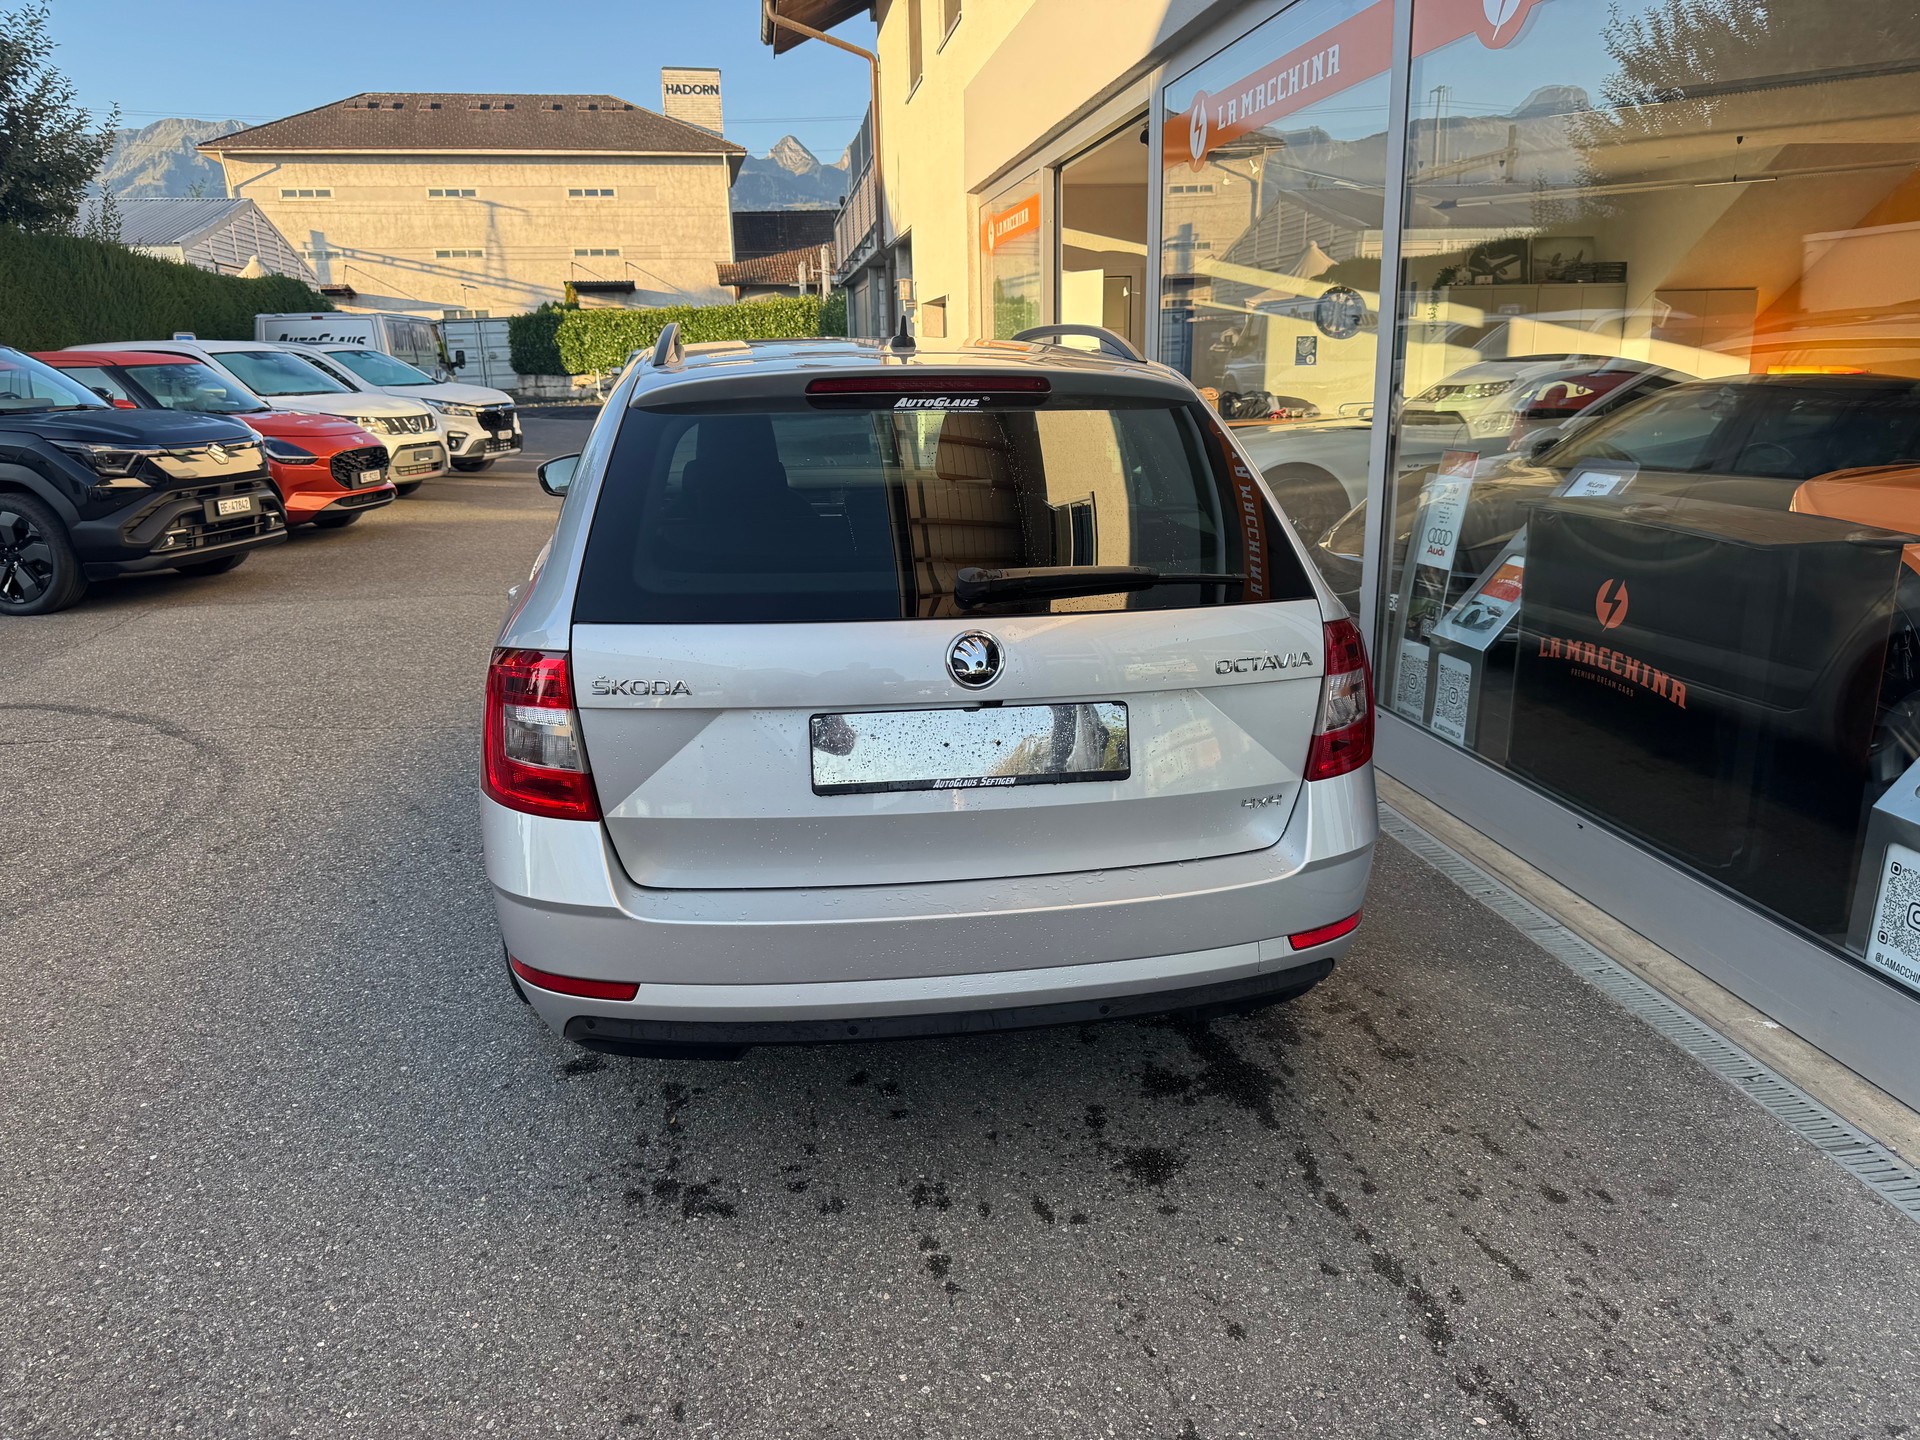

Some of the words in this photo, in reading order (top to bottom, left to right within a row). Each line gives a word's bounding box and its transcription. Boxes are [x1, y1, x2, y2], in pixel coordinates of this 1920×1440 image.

[665, 83, 719, 95] HADORN
[1217, 98, 1237, 131] LA
[1240, 43, 1340, 119] MACCHINA
[1427, 545, 1446, 557] Audi
[1215, 651, 1314, 674] OCTAVIA
[1538, 637, 1561, 658] LA
[1565, 639, 1686, 709] MACCHINA
[591, 675, 693, 696] ŠKODA
[1571, 668, 1596, 681] PREMIUM
[1597, 675, 1617, 689] DREAM
[1618, 683, 1635, 697] CARS
